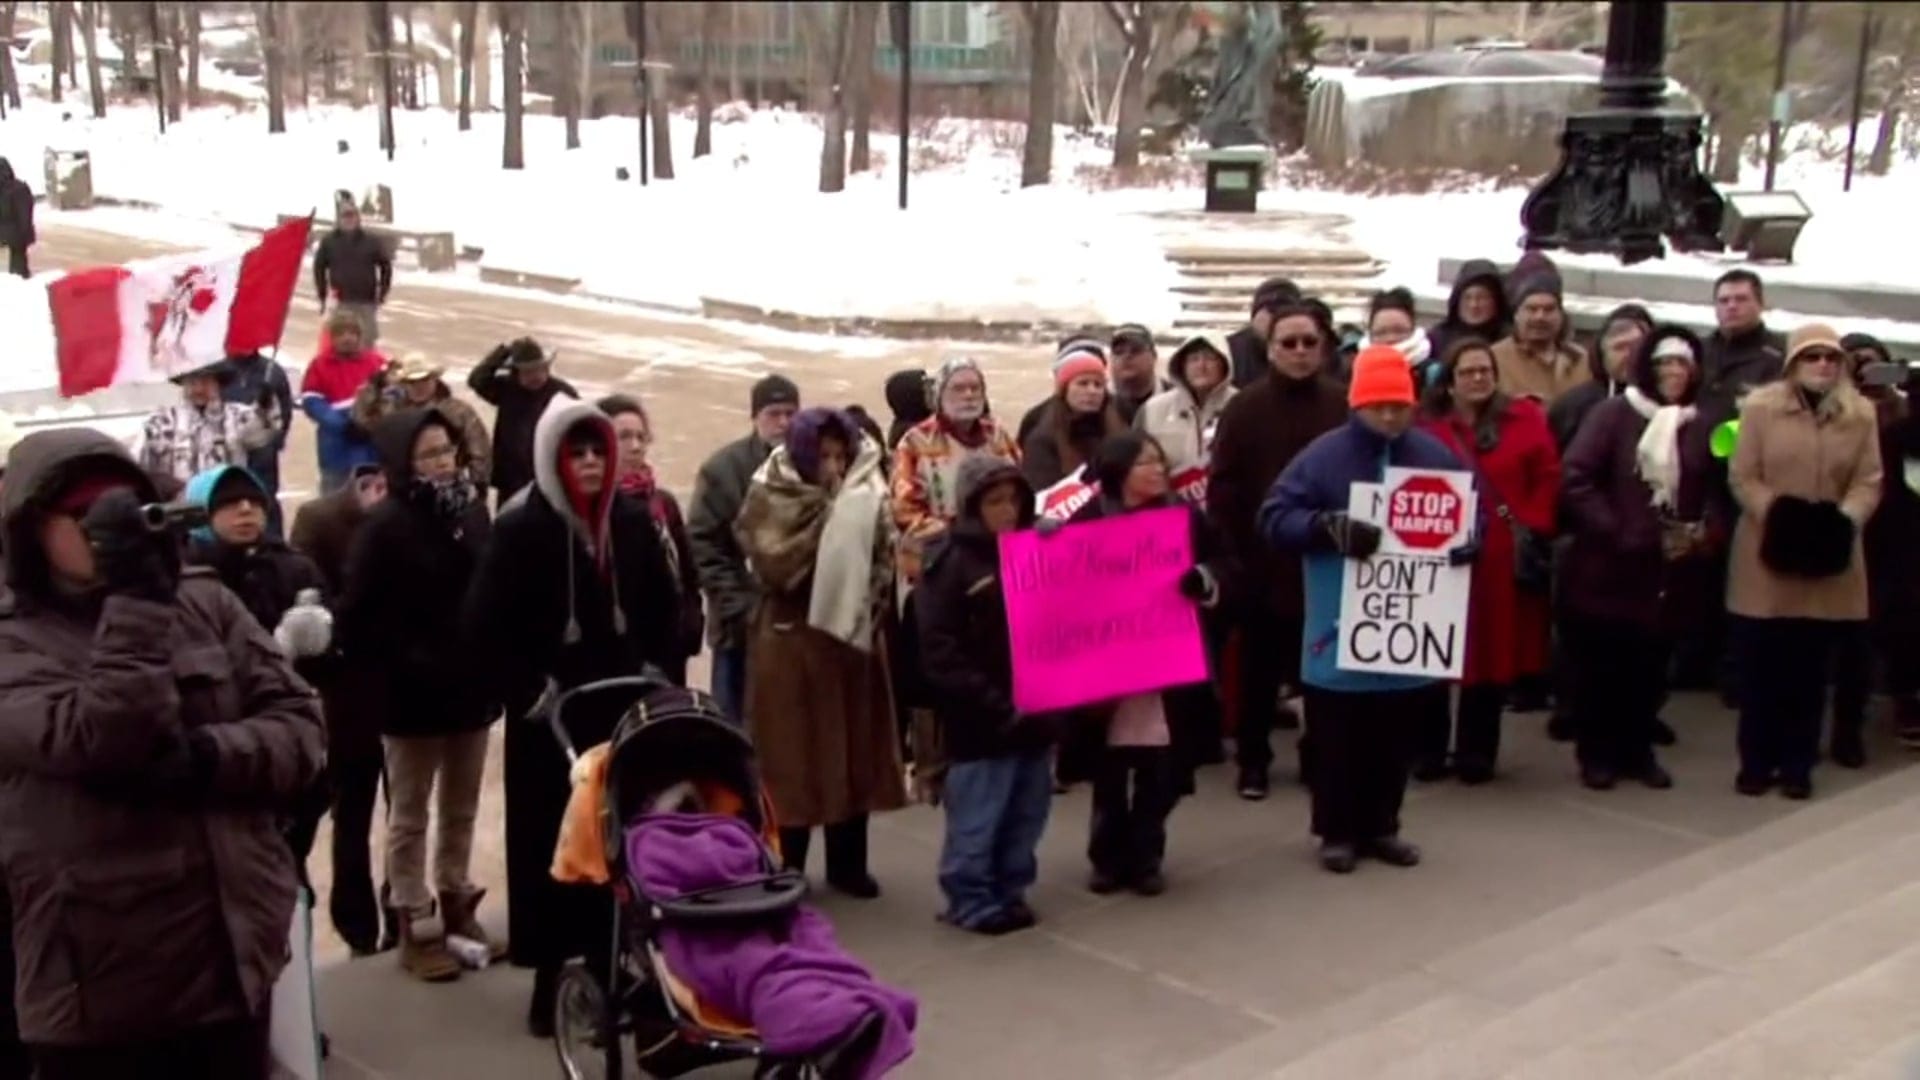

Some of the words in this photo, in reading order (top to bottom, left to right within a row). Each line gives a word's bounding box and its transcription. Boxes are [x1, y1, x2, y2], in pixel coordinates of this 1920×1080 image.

[1393, 490, 1457, 517] STOP
[1392, 515, 1454, 534] HARPER
[1356, 559, 1445, 594] DON'T
[1362, 592, 1421, 620] GET
[1350, 620, 1455, 670] CON
